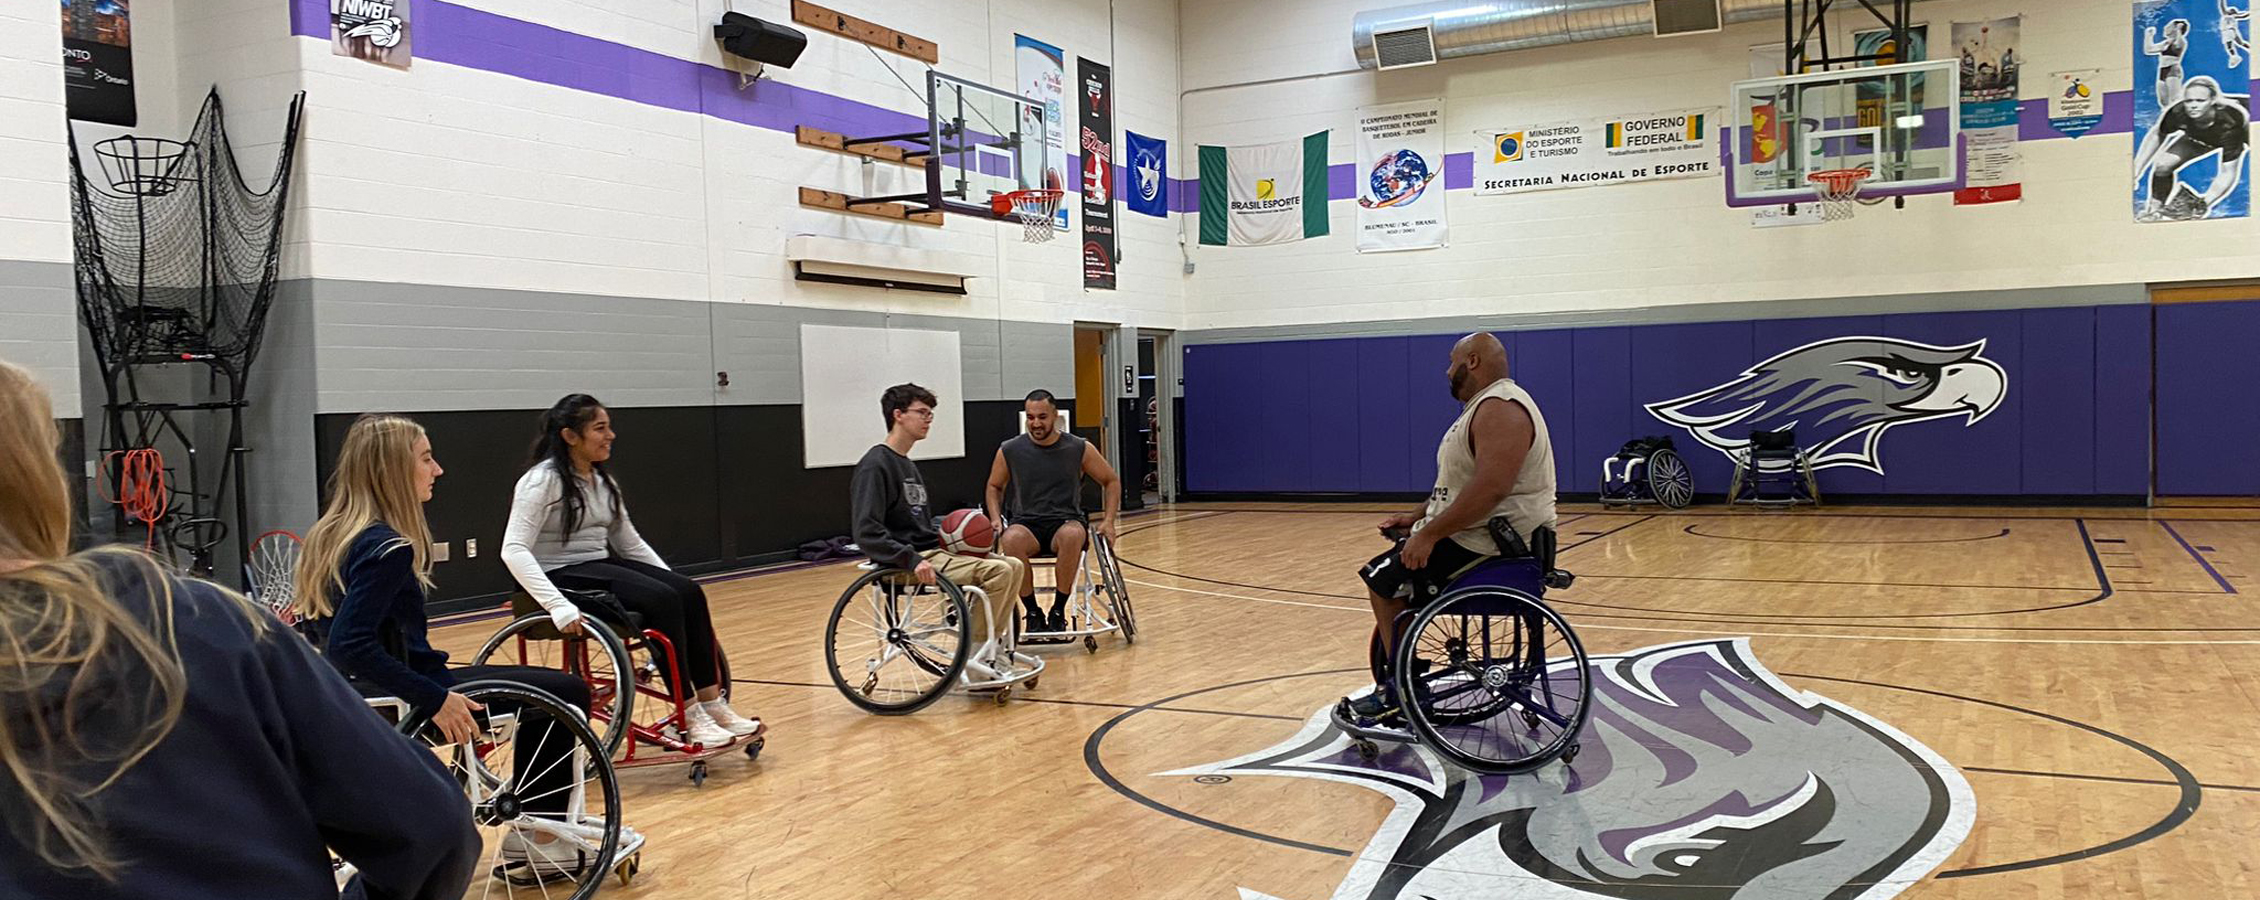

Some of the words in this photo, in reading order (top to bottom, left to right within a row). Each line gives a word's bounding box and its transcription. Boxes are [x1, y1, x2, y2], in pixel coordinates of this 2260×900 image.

[1625, 116, 1685, 131] GOVERNO
[1526, 140, 1539, 148] DO
[1541, 136, 1582, 147] ESPORTE
[1627, 132, 1683, 146] FEDERAL
[1531, 150, 1536, 158] E
[1538, 147, 1578, 158] TURISMO
[1231, 200, 1261, 210] BRASIL
[1263, 196, 1300, 208] ESPORTE
